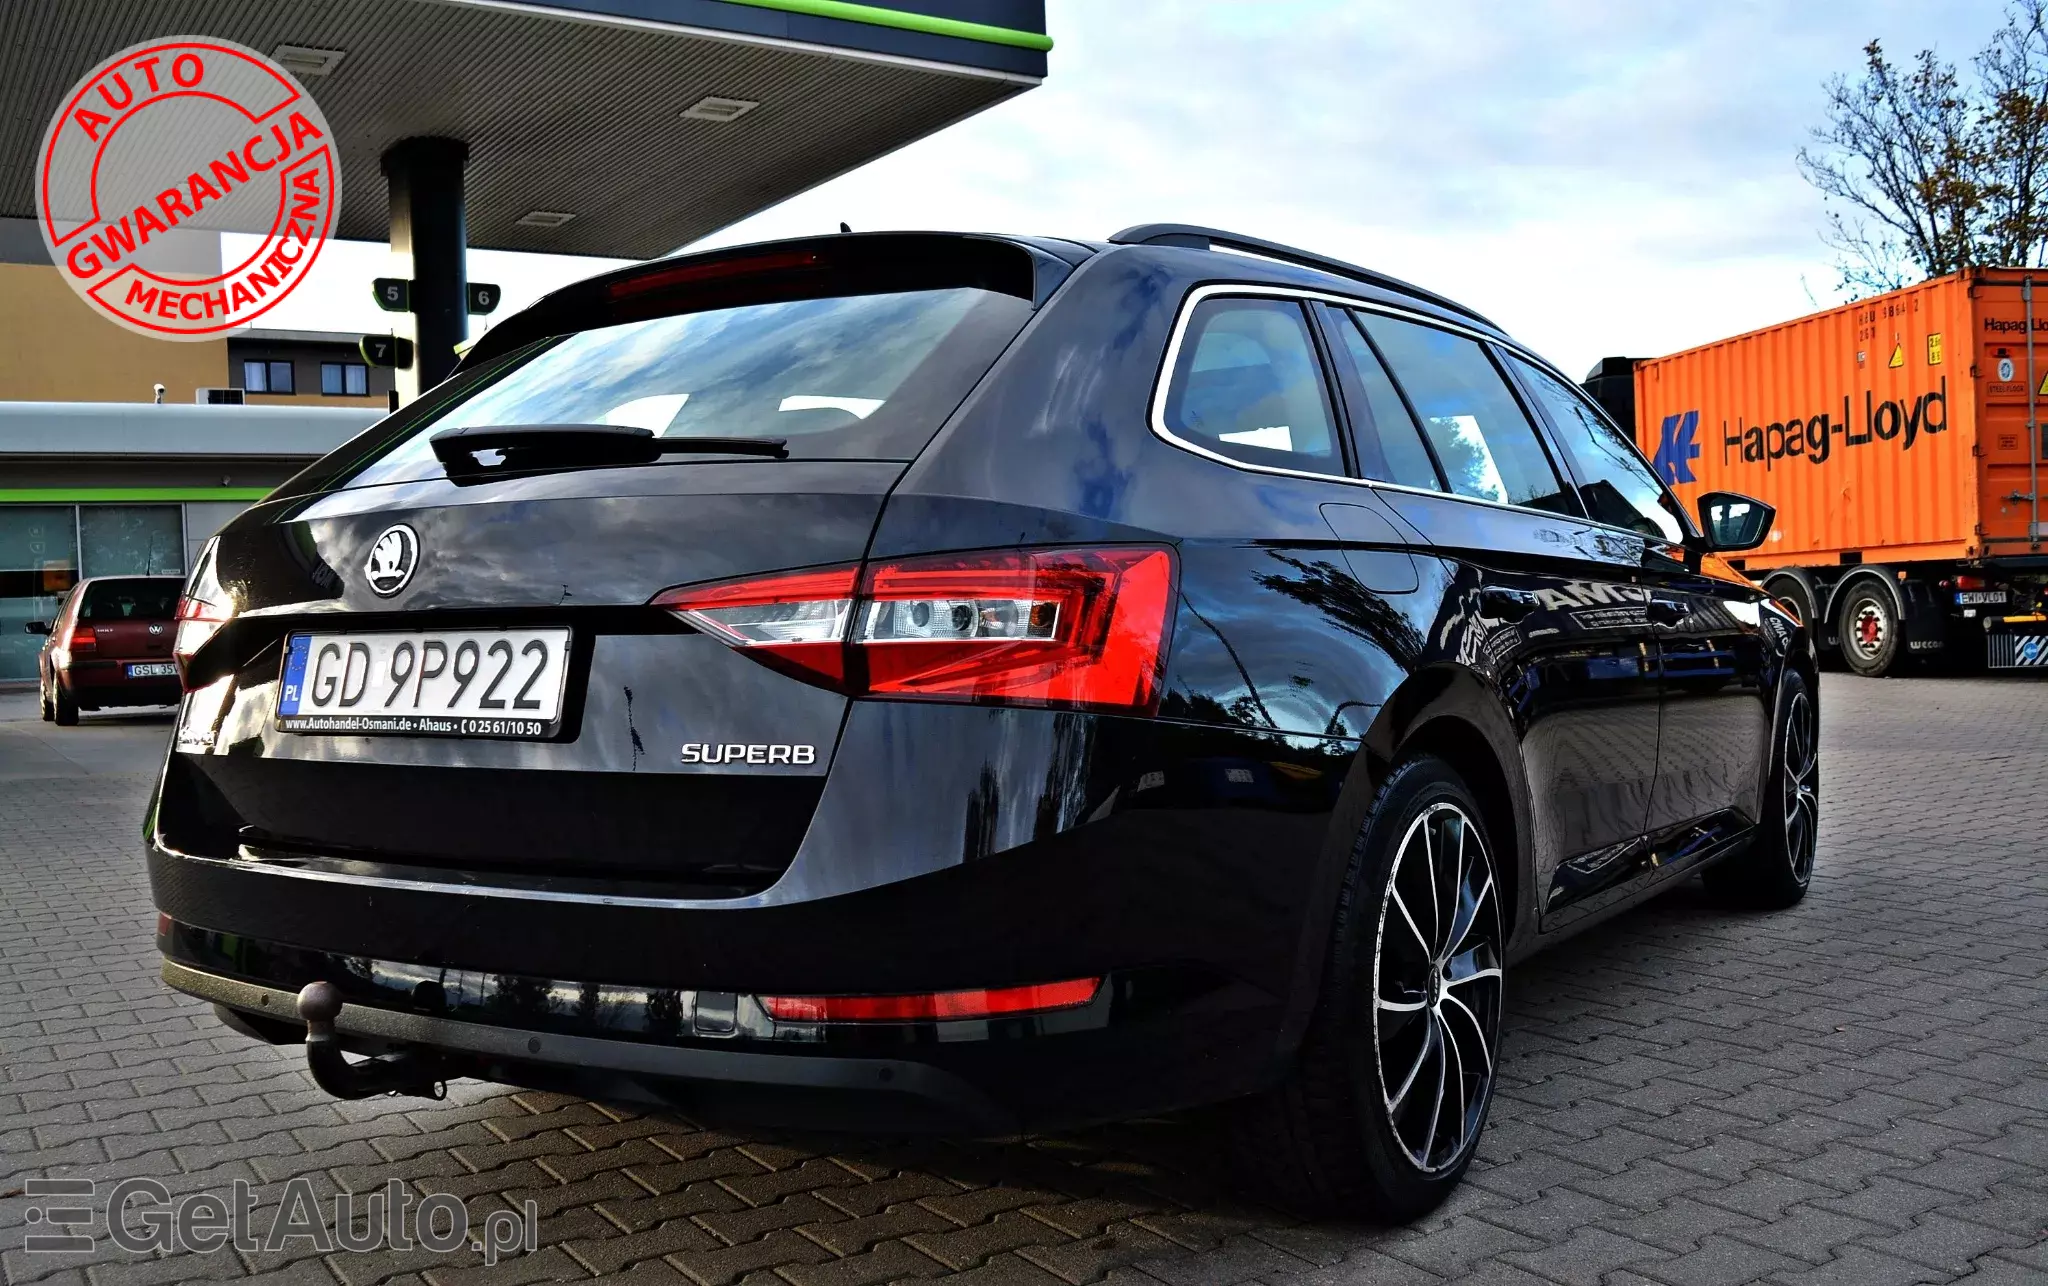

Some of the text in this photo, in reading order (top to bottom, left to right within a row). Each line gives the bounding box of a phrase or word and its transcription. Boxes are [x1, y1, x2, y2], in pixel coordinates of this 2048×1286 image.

[386, 286, 399, 301] 5
[478, 291, 490, 306] 6
[375, 344, 387, 358] 7
[1723, 375, 1947, 471] Hapag-Lloyd
[134, 665, 157, 676] GSL
[311, 638, 549, 710] GD 9P922
[285, 685, 299, 701] PL
[285, 716, 412, 732] www.Autohandel-Osmani.de
[419, 718, 451, 732] Ahaus
[526, 722, 542, 735] 50
[680, 743, 816, 766] SUPERB
